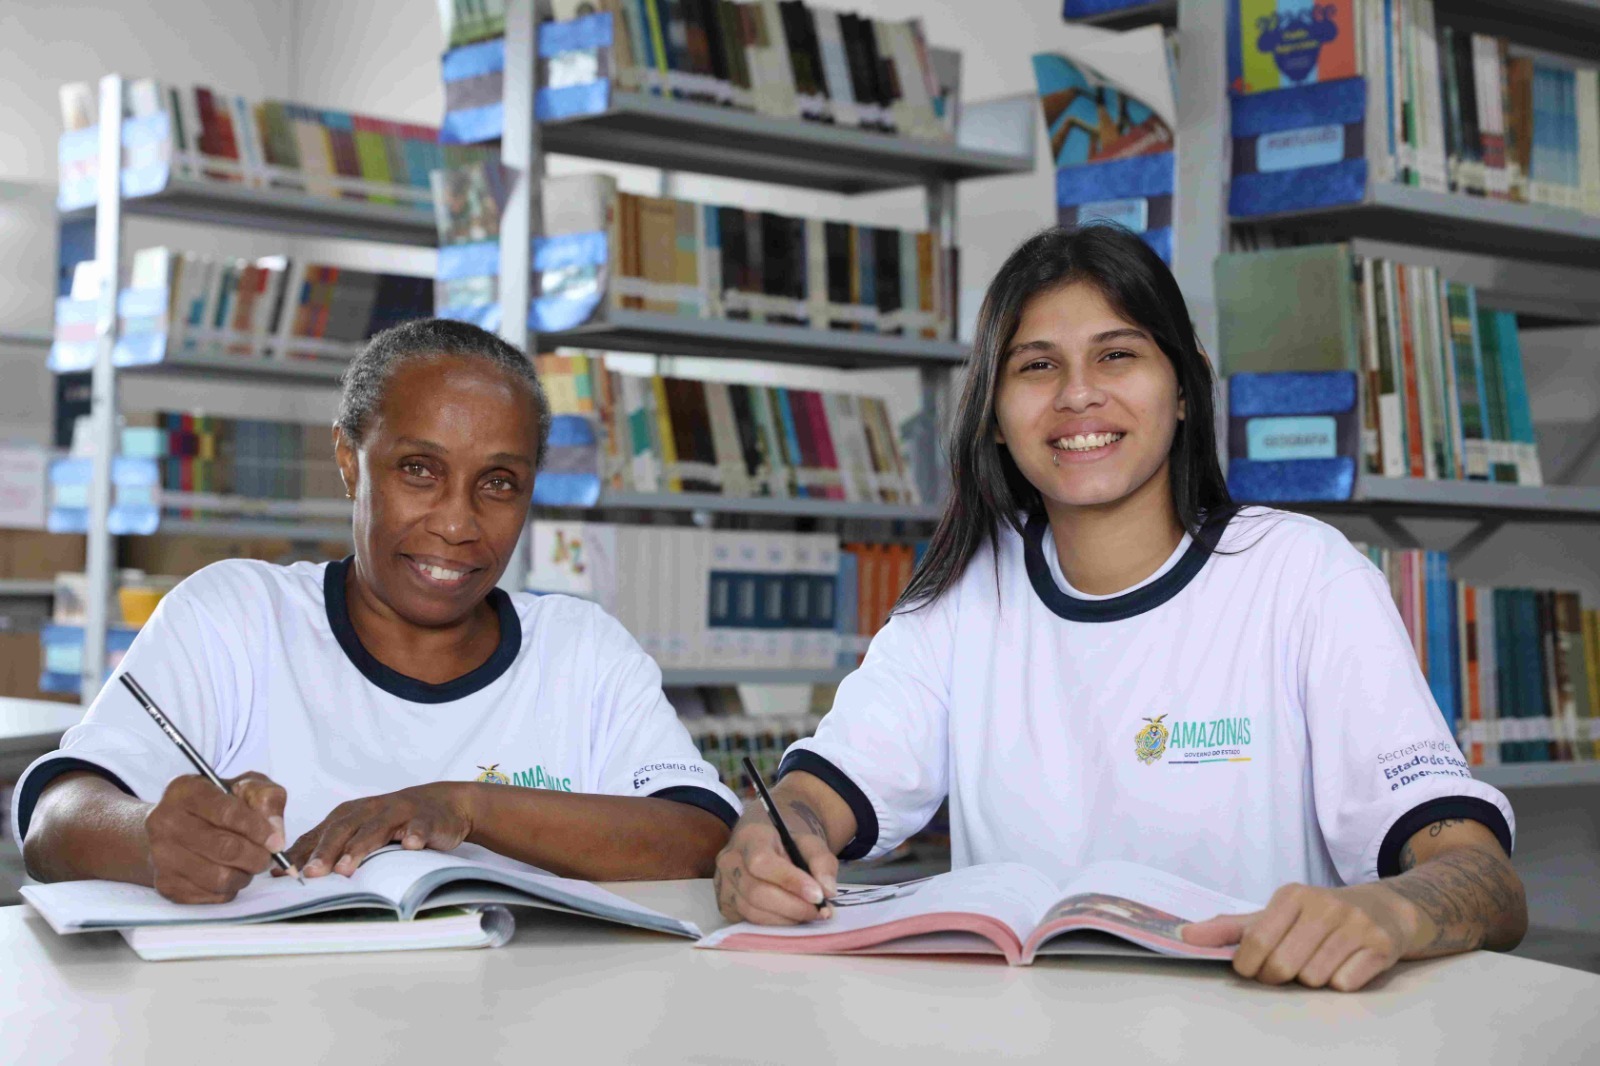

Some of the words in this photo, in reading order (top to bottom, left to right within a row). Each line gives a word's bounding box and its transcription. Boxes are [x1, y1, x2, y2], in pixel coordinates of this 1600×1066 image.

[1169, 717, 1251, 748] AMAZONAS
[1377, 739, 1436, 764] Secretaria
[1438, 740, 1451, 752] de
[513, 765, 571, 792] AMANAS
[689, 764, 704, 774] de
[1384, 755, 1429, 780] Estado
[1430, 754, 1444, 765] de
[1391, 782, 1399, 791] e
